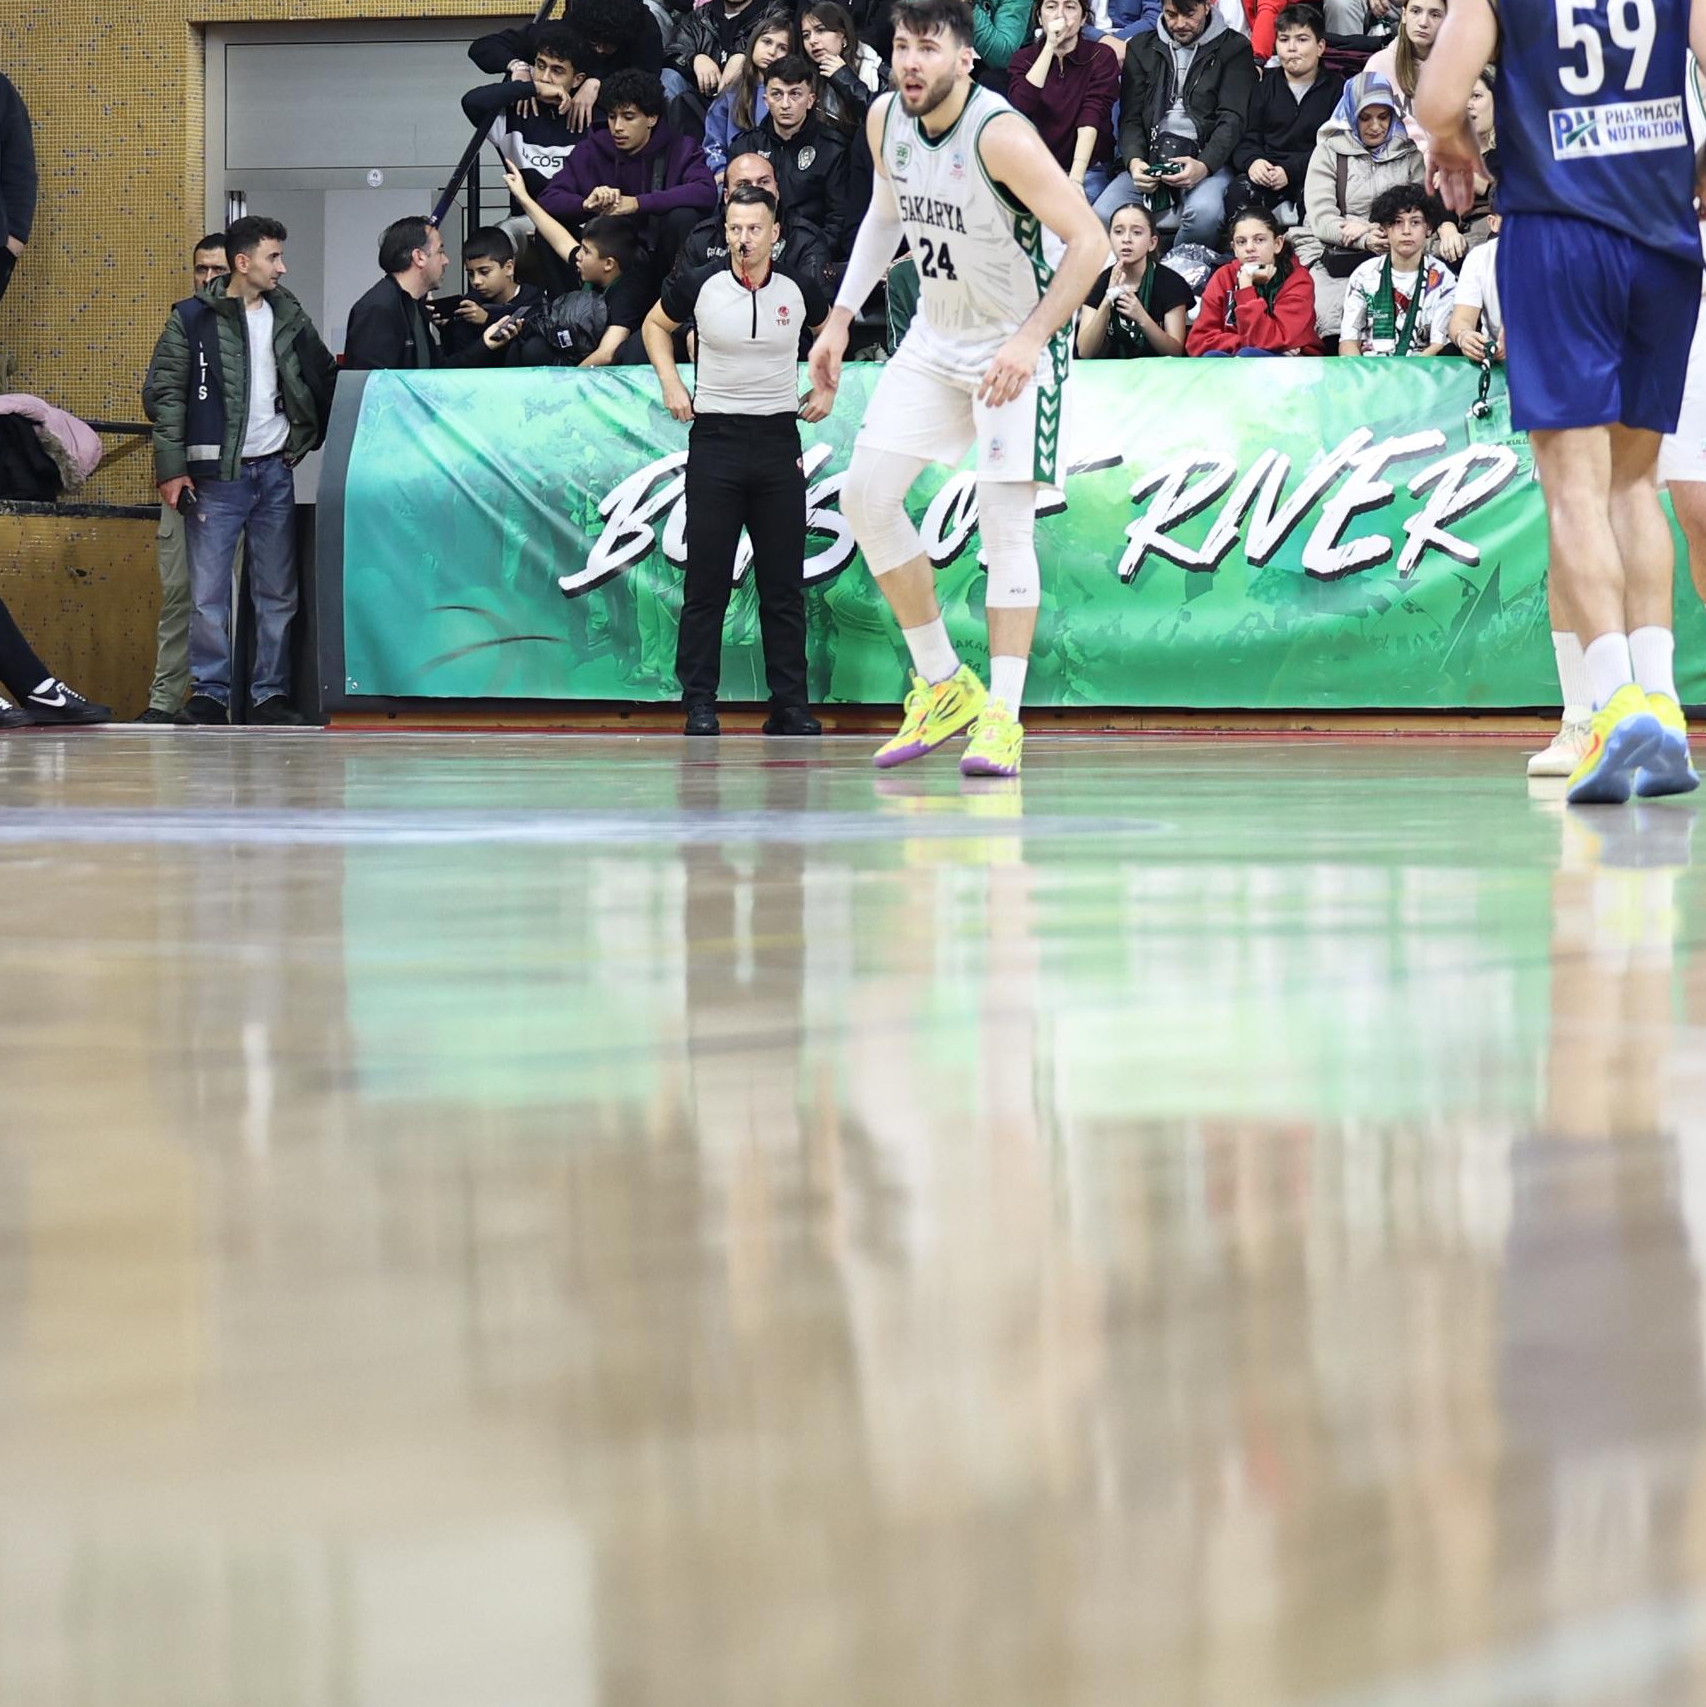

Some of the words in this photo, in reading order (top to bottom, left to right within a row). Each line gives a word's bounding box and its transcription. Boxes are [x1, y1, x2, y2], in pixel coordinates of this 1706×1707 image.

[1605, 101, 1682, 125] PHARMACY
[1606, 120, 1684, 143] NUTRITION
[899, 195, 967, 235] SAKARYA
[919, 237, 958, 281] 24
[1117, 426, 1519, 584] RIVER
